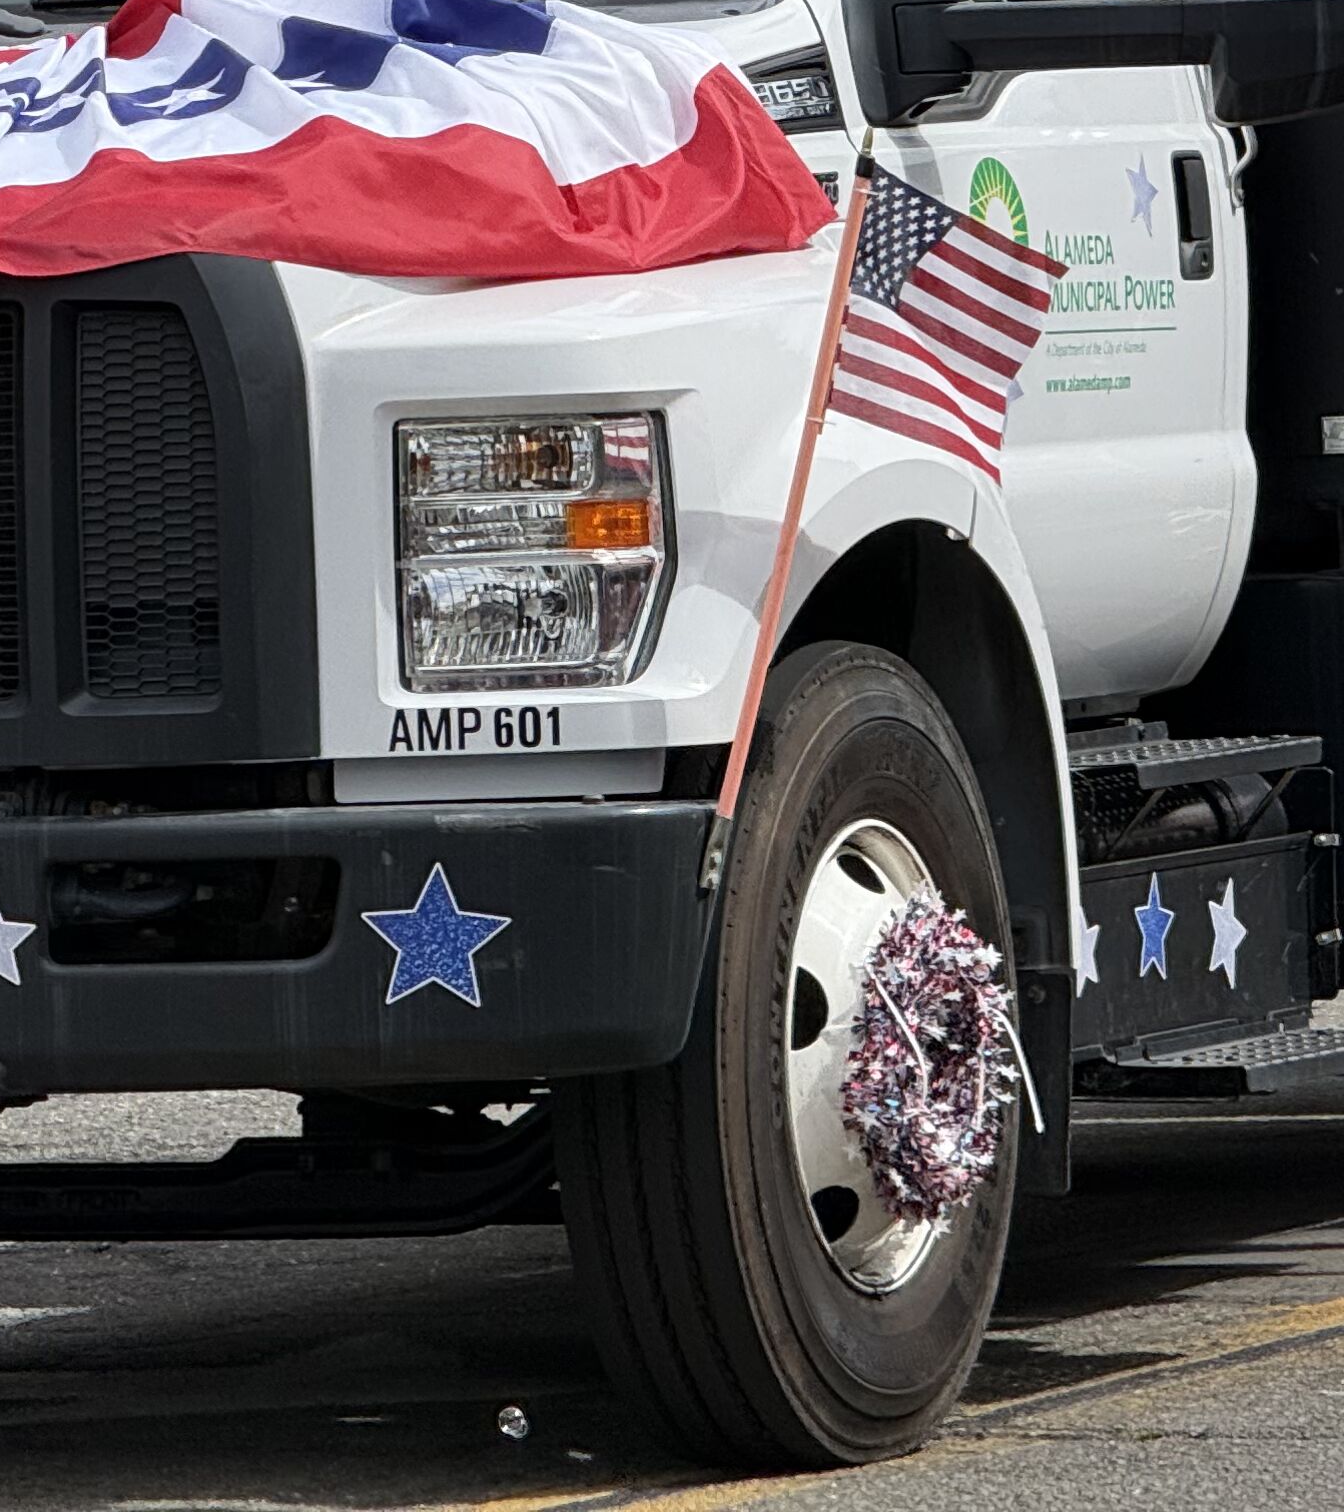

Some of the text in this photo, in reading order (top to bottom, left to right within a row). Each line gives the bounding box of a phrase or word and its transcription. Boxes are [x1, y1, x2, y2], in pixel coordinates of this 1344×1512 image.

[1044, 230, 1115, 265] ALAMEDA
[1124, 274, 1176, 311] POWER
[389, 706, 561, 752] AMP 601
